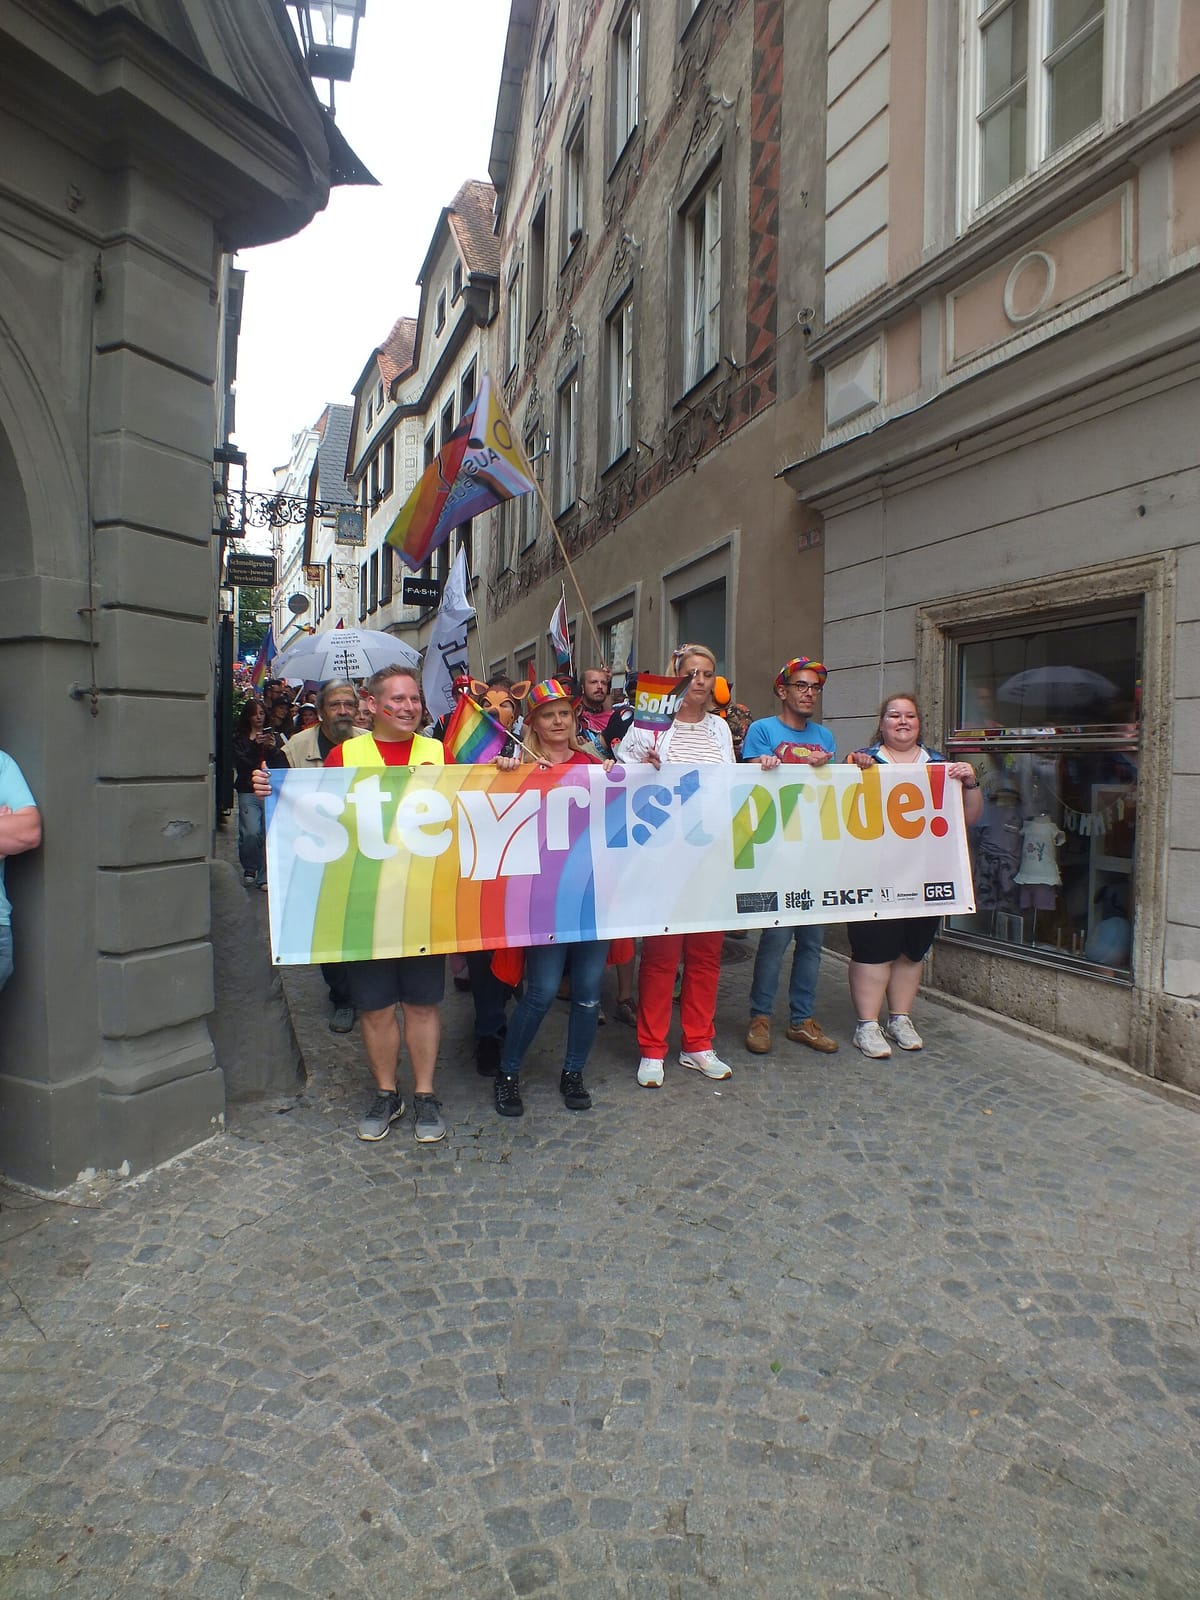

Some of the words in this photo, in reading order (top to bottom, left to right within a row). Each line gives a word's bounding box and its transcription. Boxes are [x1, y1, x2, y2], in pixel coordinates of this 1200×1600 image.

[605, 764, 713, 848] ist
[730, 764, 949, 869] pride!
[785, 889, 811, 901] stadt
[822, 888, 873, 906] SKF
[925, 885, 953, 898] GRS
